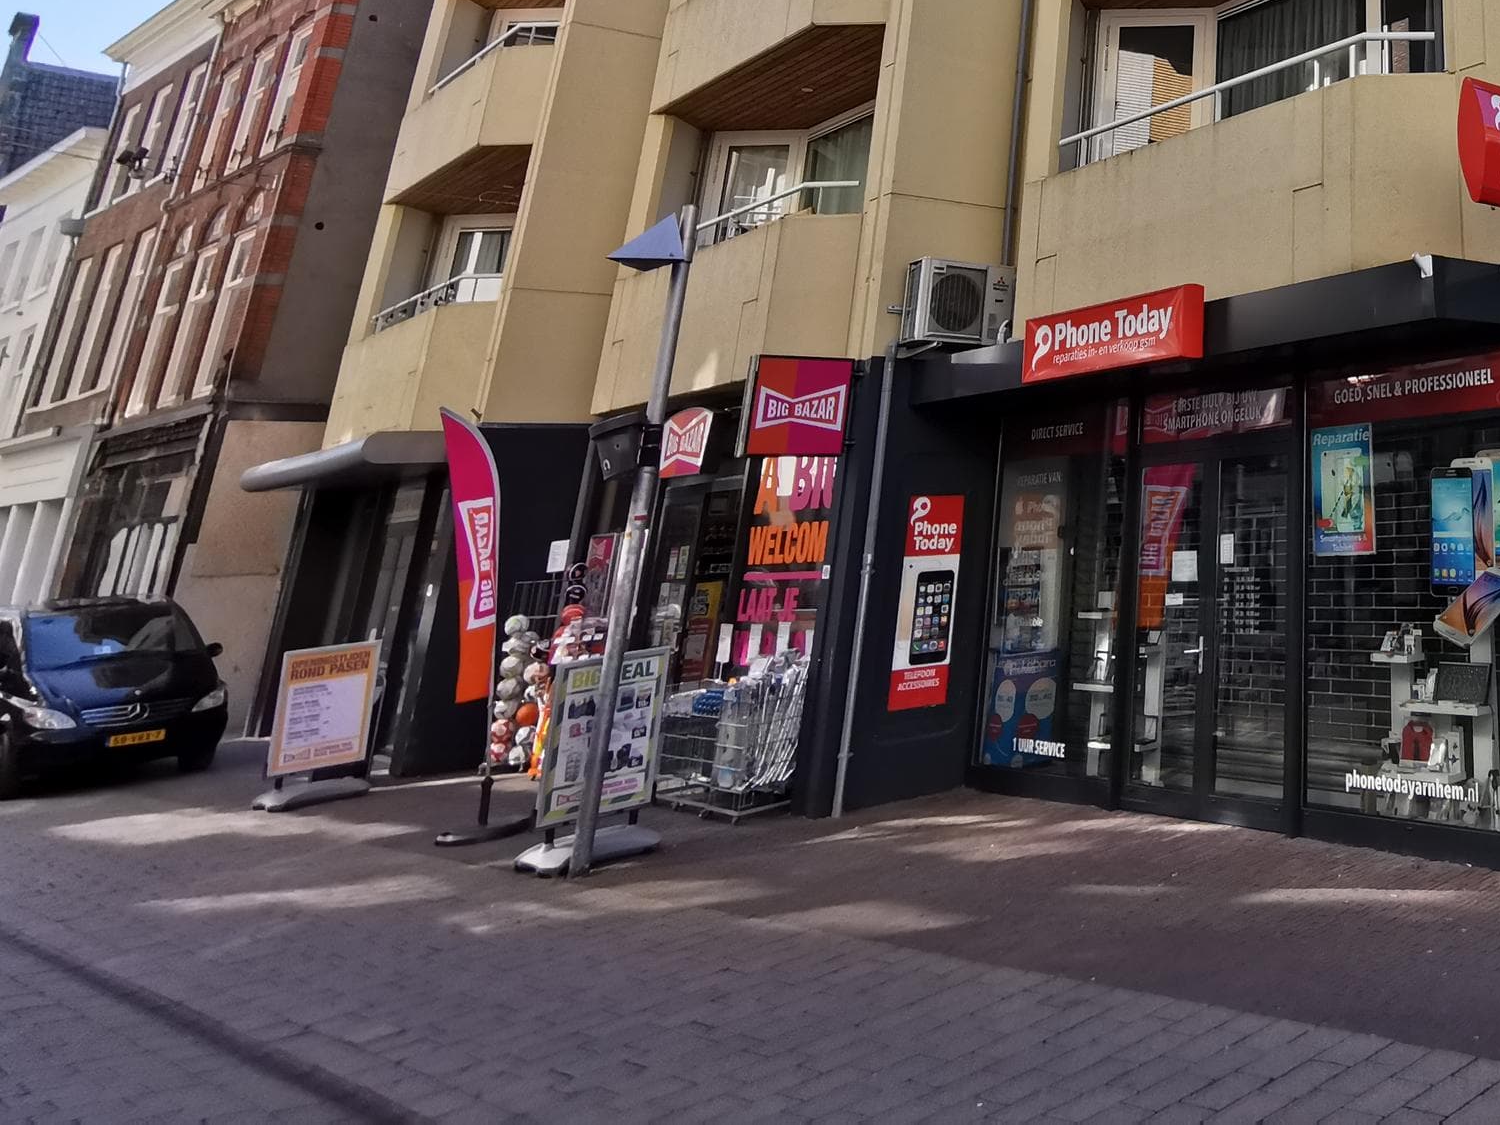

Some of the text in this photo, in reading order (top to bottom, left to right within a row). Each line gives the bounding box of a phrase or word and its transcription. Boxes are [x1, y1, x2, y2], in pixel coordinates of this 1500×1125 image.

[1054, 304, 1173, 351] Phone Today
[1053, 346, 1088, 366] reparaties
[1098, 346, 1109, 356] en
[1109, 338, 1139, 355] verkoop
[1139, 336, 1157, 352] gsm
[1334, 368, 1494, 404] GOED, SNEL & PROFESSIONEEL
[767, 396, 836, 421] BIG BAZAR
[1031, 422, 1084, 441] DIRECT SERVICE
[1312, 429, 1371, 447] Reparatie
[914, 521, 957, 535] Phone
[913, 536, 955, 552] Today
[290, 659, 370, 681] ROND PASEN
[621, 661, 655, 680] EAL
[1012, 737, 1066, 758] 1 UUR SERVICE
[1345, 769, 1479, 804] phonetodayarnhem.nl
